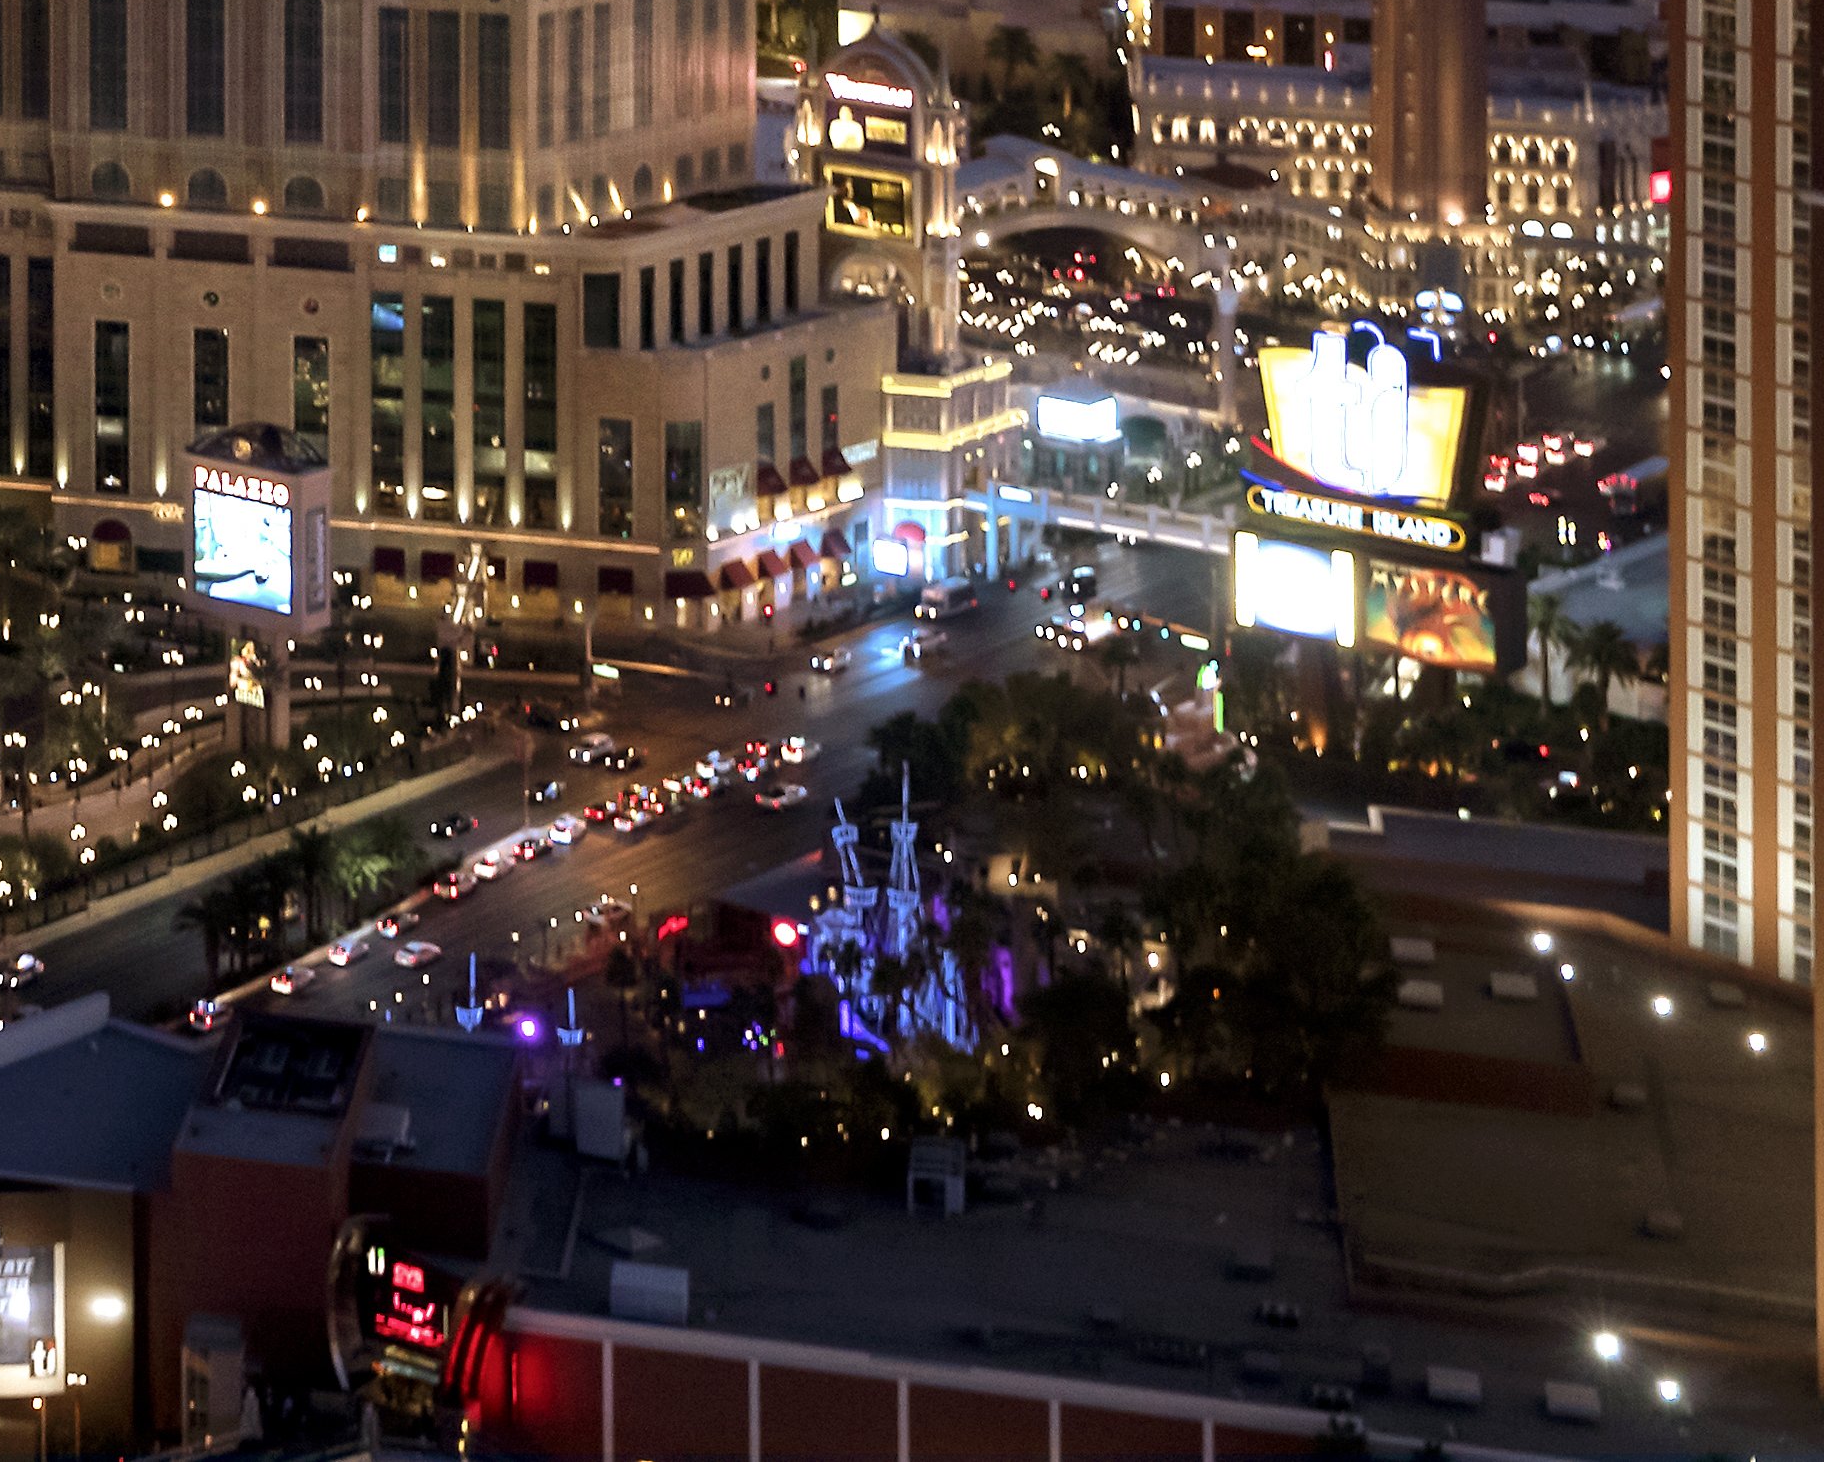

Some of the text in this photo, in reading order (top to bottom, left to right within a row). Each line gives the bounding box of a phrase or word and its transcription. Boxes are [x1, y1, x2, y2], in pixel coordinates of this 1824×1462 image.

[194, 464, 291, 507] PALAZZO
[1260, 488, 1452, 547] TREASURE ISLAND
